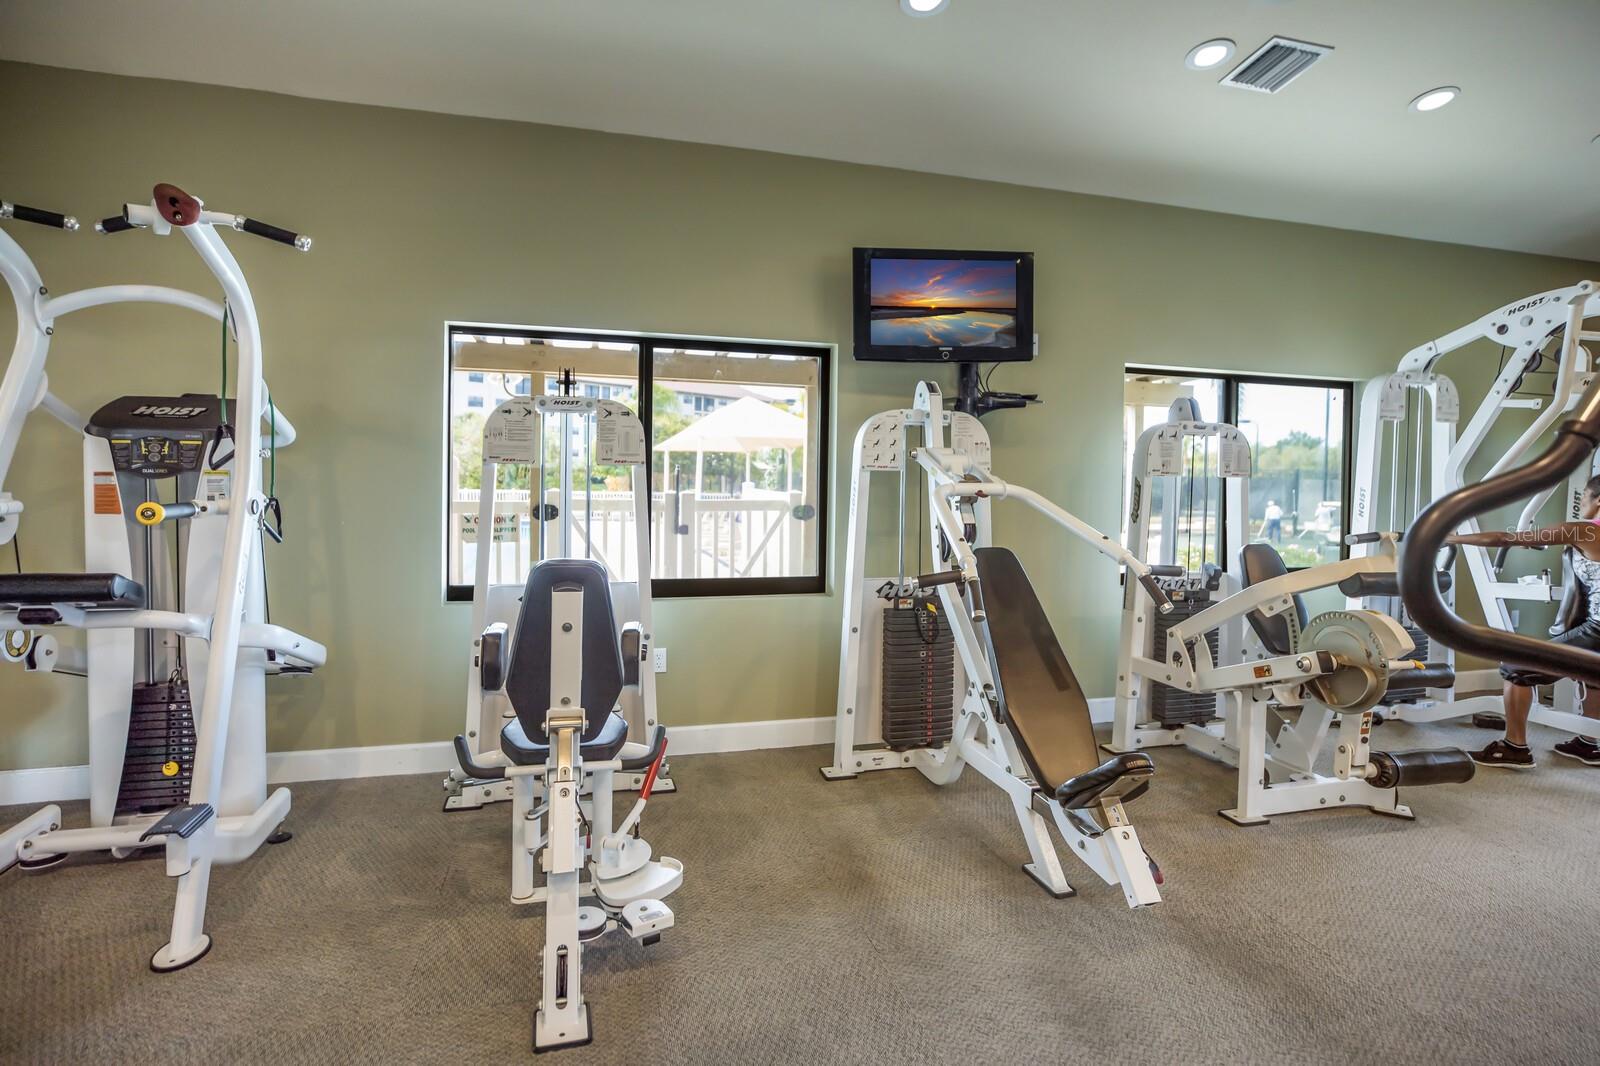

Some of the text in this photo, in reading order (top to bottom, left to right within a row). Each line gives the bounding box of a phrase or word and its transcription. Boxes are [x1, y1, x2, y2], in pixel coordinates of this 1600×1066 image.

[1507, 297, 1545, 316] HOIST
[133, 406, 207, 416] HOIST
[1571, 490, 1581, 520] HOIST
